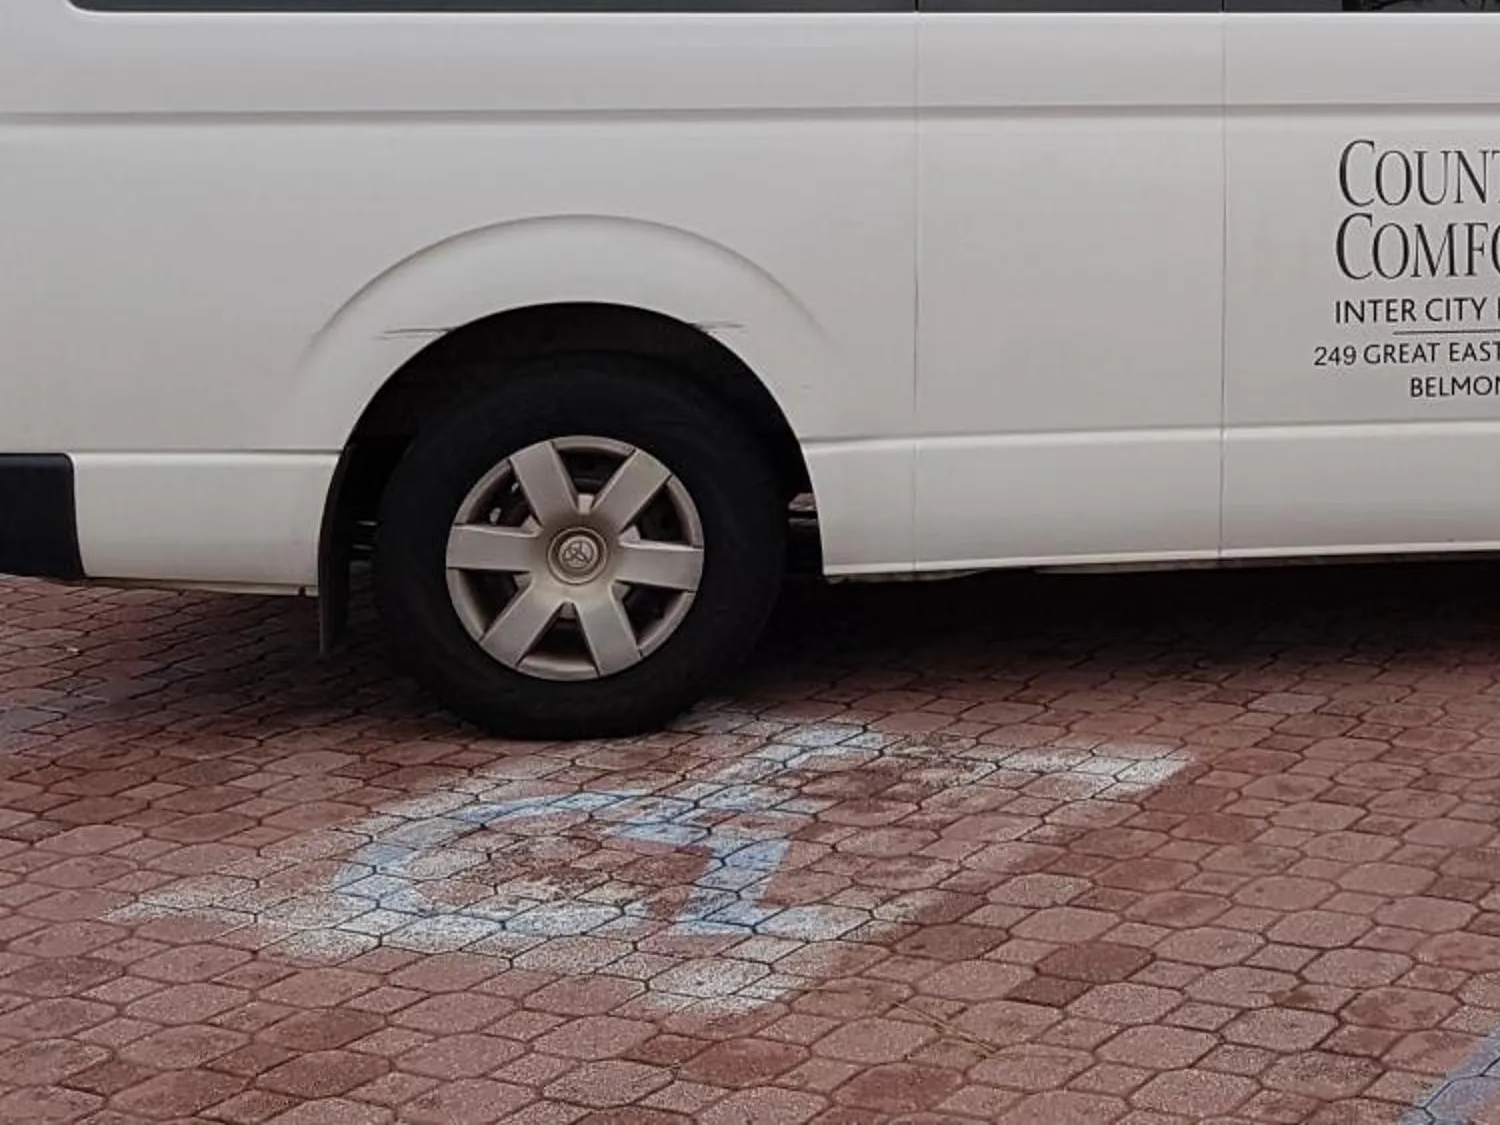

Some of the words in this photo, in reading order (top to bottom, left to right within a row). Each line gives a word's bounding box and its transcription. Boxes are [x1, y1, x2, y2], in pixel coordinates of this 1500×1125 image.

[1335, 298, 1418, 325] INTER
[1424, 296, 1488, 323] CITY
[1313, 344, 1357, 367] 249
[1363, 342, 1441, 366] GREAT
